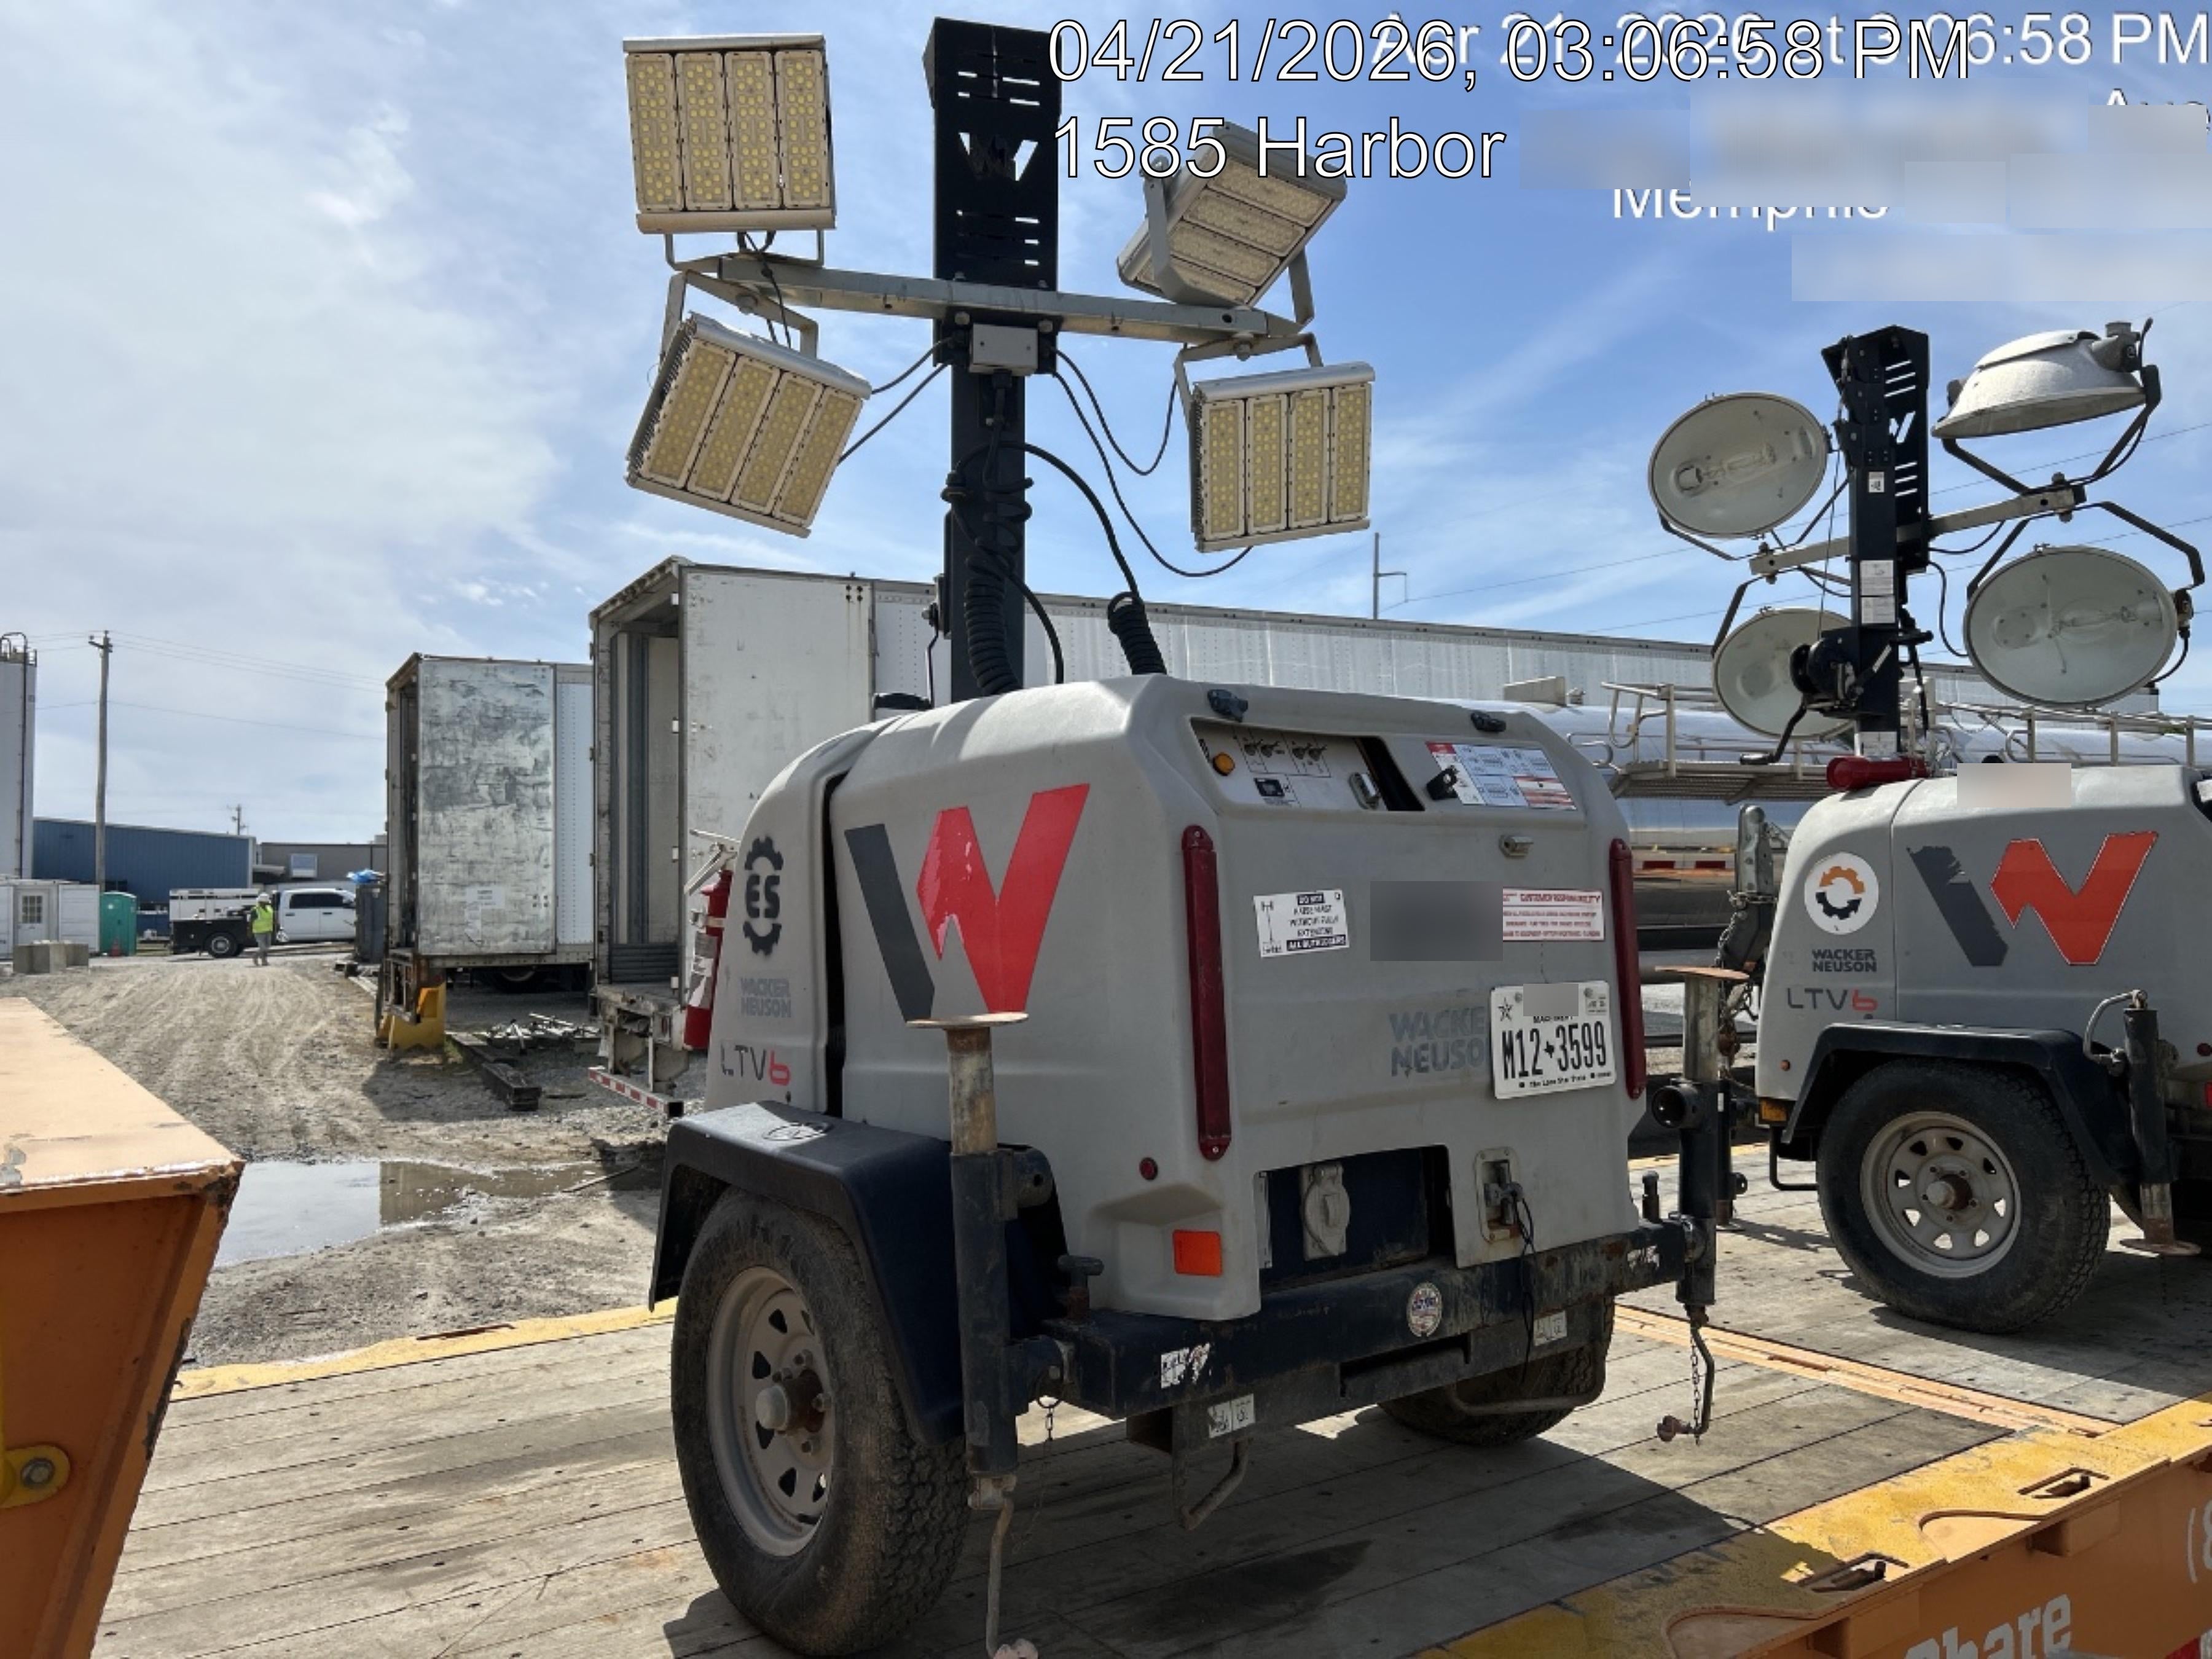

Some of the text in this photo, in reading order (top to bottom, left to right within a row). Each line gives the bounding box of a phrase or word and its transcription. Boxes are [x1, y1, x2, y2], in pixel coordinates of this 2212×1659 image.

[1811, 949, 1877, 961] WACKER
[1813, 961, 1877, 972] NEUSON
[740, 978, 791, 997] WACKER
[740, 997, 791, 1018] NEUSON
[1787, 987, 1879, 1011] LTV6
[1389, 1006, 1486, 1042] WACKE
[720, 1044, 791, 1086] LTV6
[1391, 1037, 1490, 1077] NEUSO
